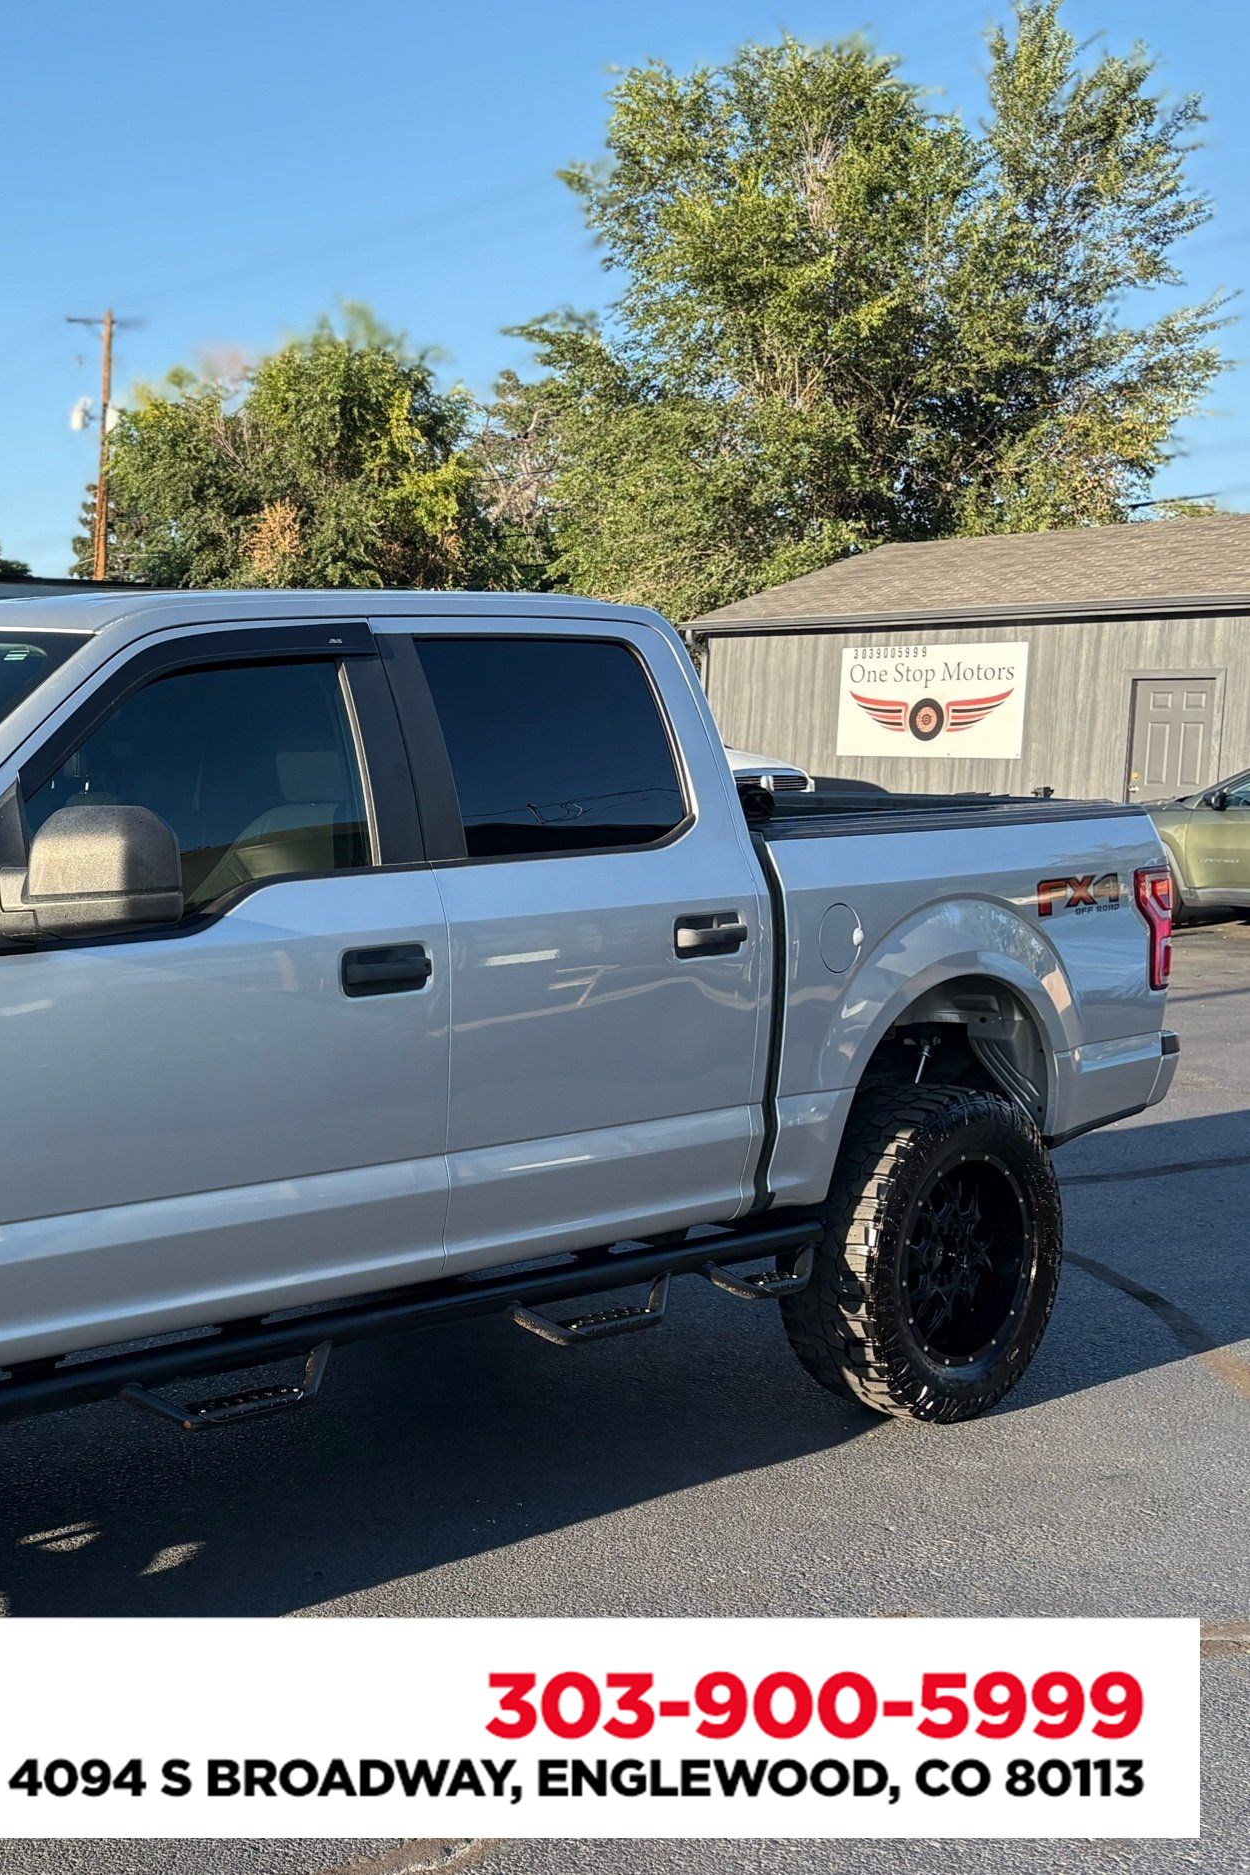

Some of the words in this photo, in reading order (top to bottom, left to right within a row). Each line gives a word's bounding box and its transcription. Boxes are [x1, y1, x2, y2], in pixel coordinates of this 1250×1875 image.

[853, 646, 928, 660] 3039005999
[849, 663, 889, 683] One
[893, 662, 936, 689] Stop
[940, 660, 1015, 682] Motors
[1036, 872, 1120, 917] FX4
[1075, 905, 1094, 915] OFF
[1096, 903, 1120, 913] ROAD
